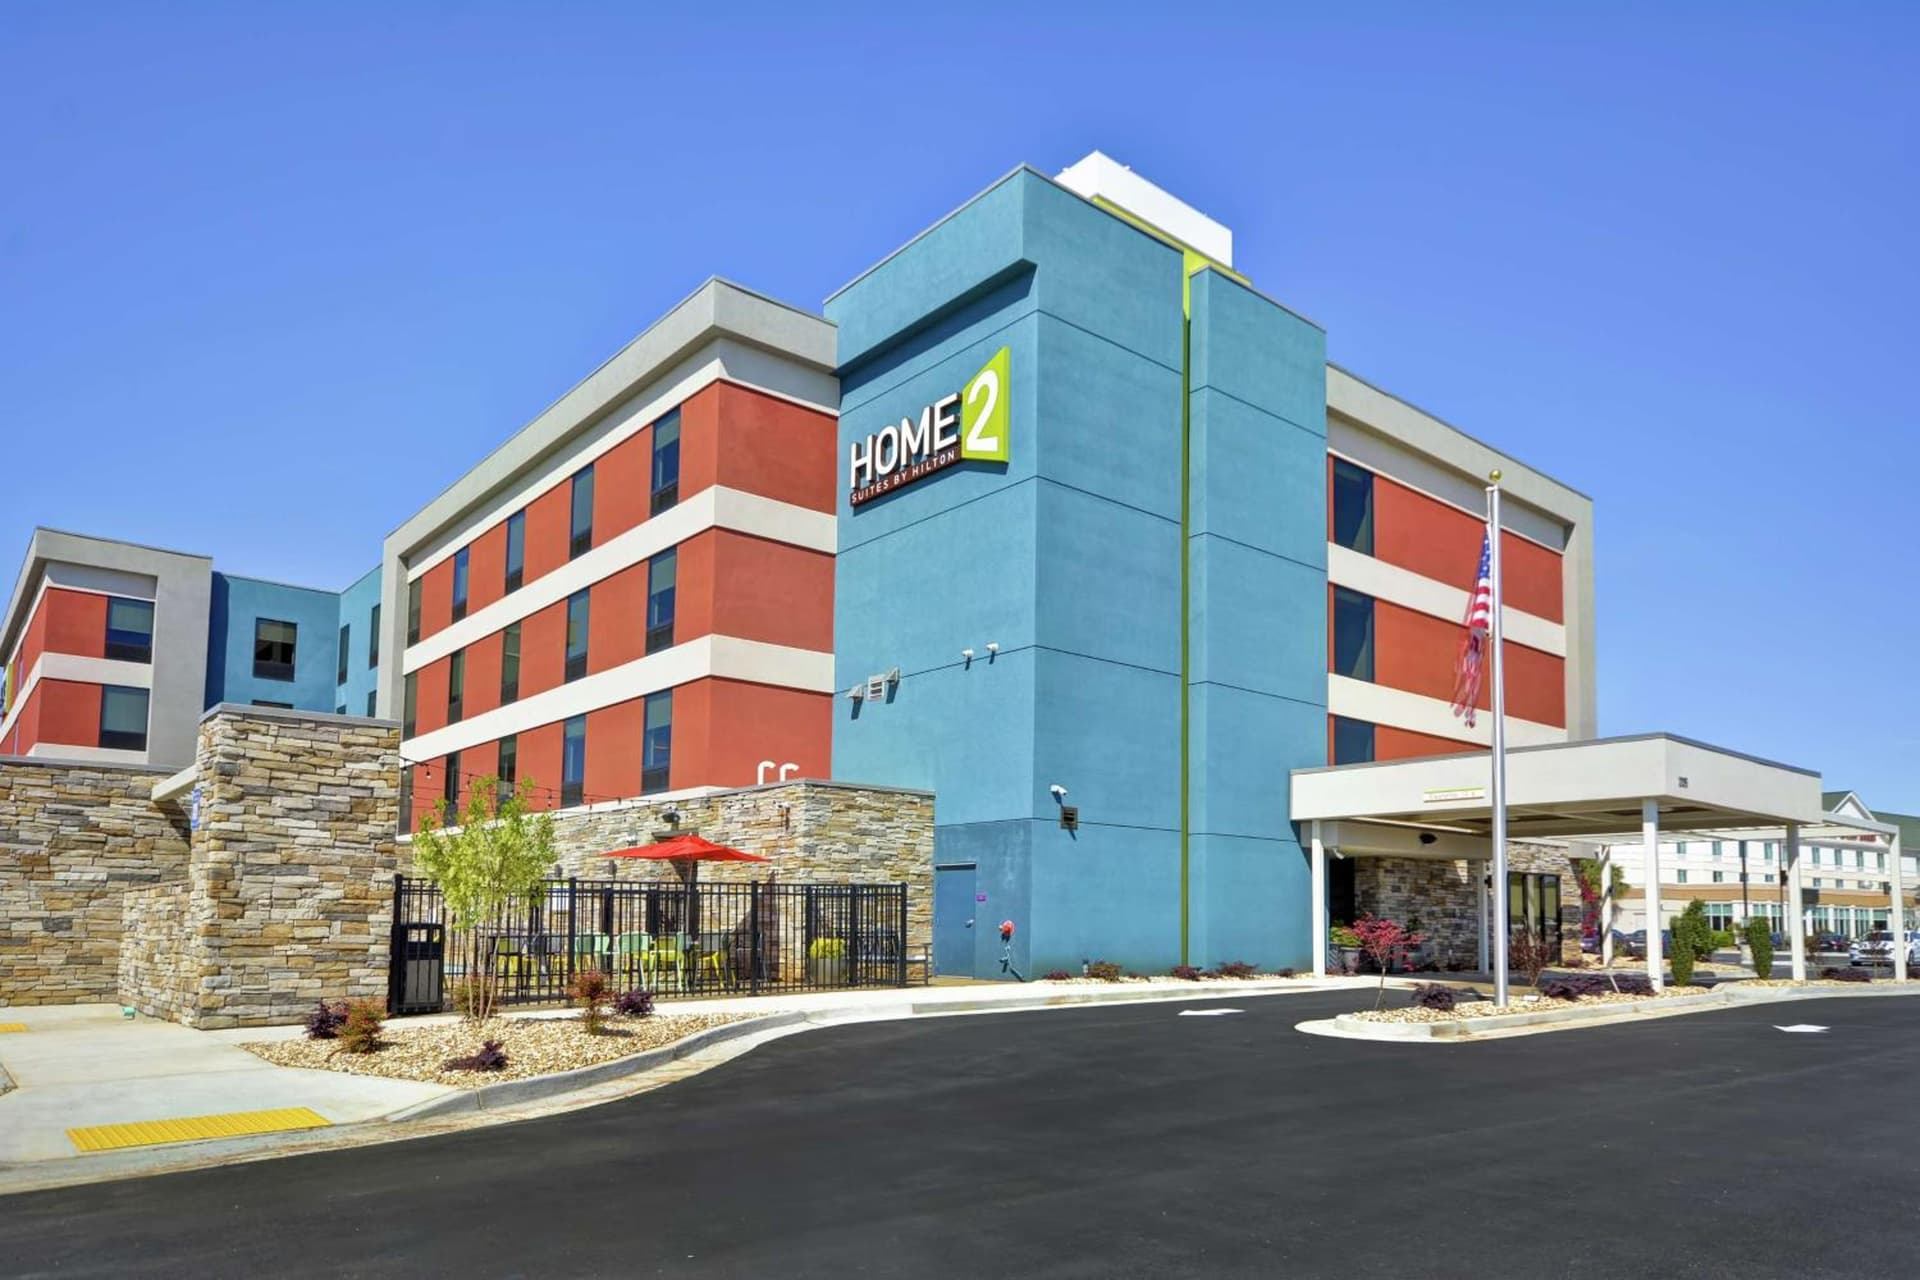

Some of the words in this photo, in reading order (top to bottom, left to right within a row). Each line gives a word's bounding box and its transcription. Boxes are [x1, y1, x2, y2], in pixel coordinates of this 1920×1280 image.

[850, 392, 959, 489] HOME
[966, 369, 999, 452] 2
[851, 480, 889, 504] SUITES
[894, 471, 907, 485] BY
[912, 450, 955, 476] HILTON
